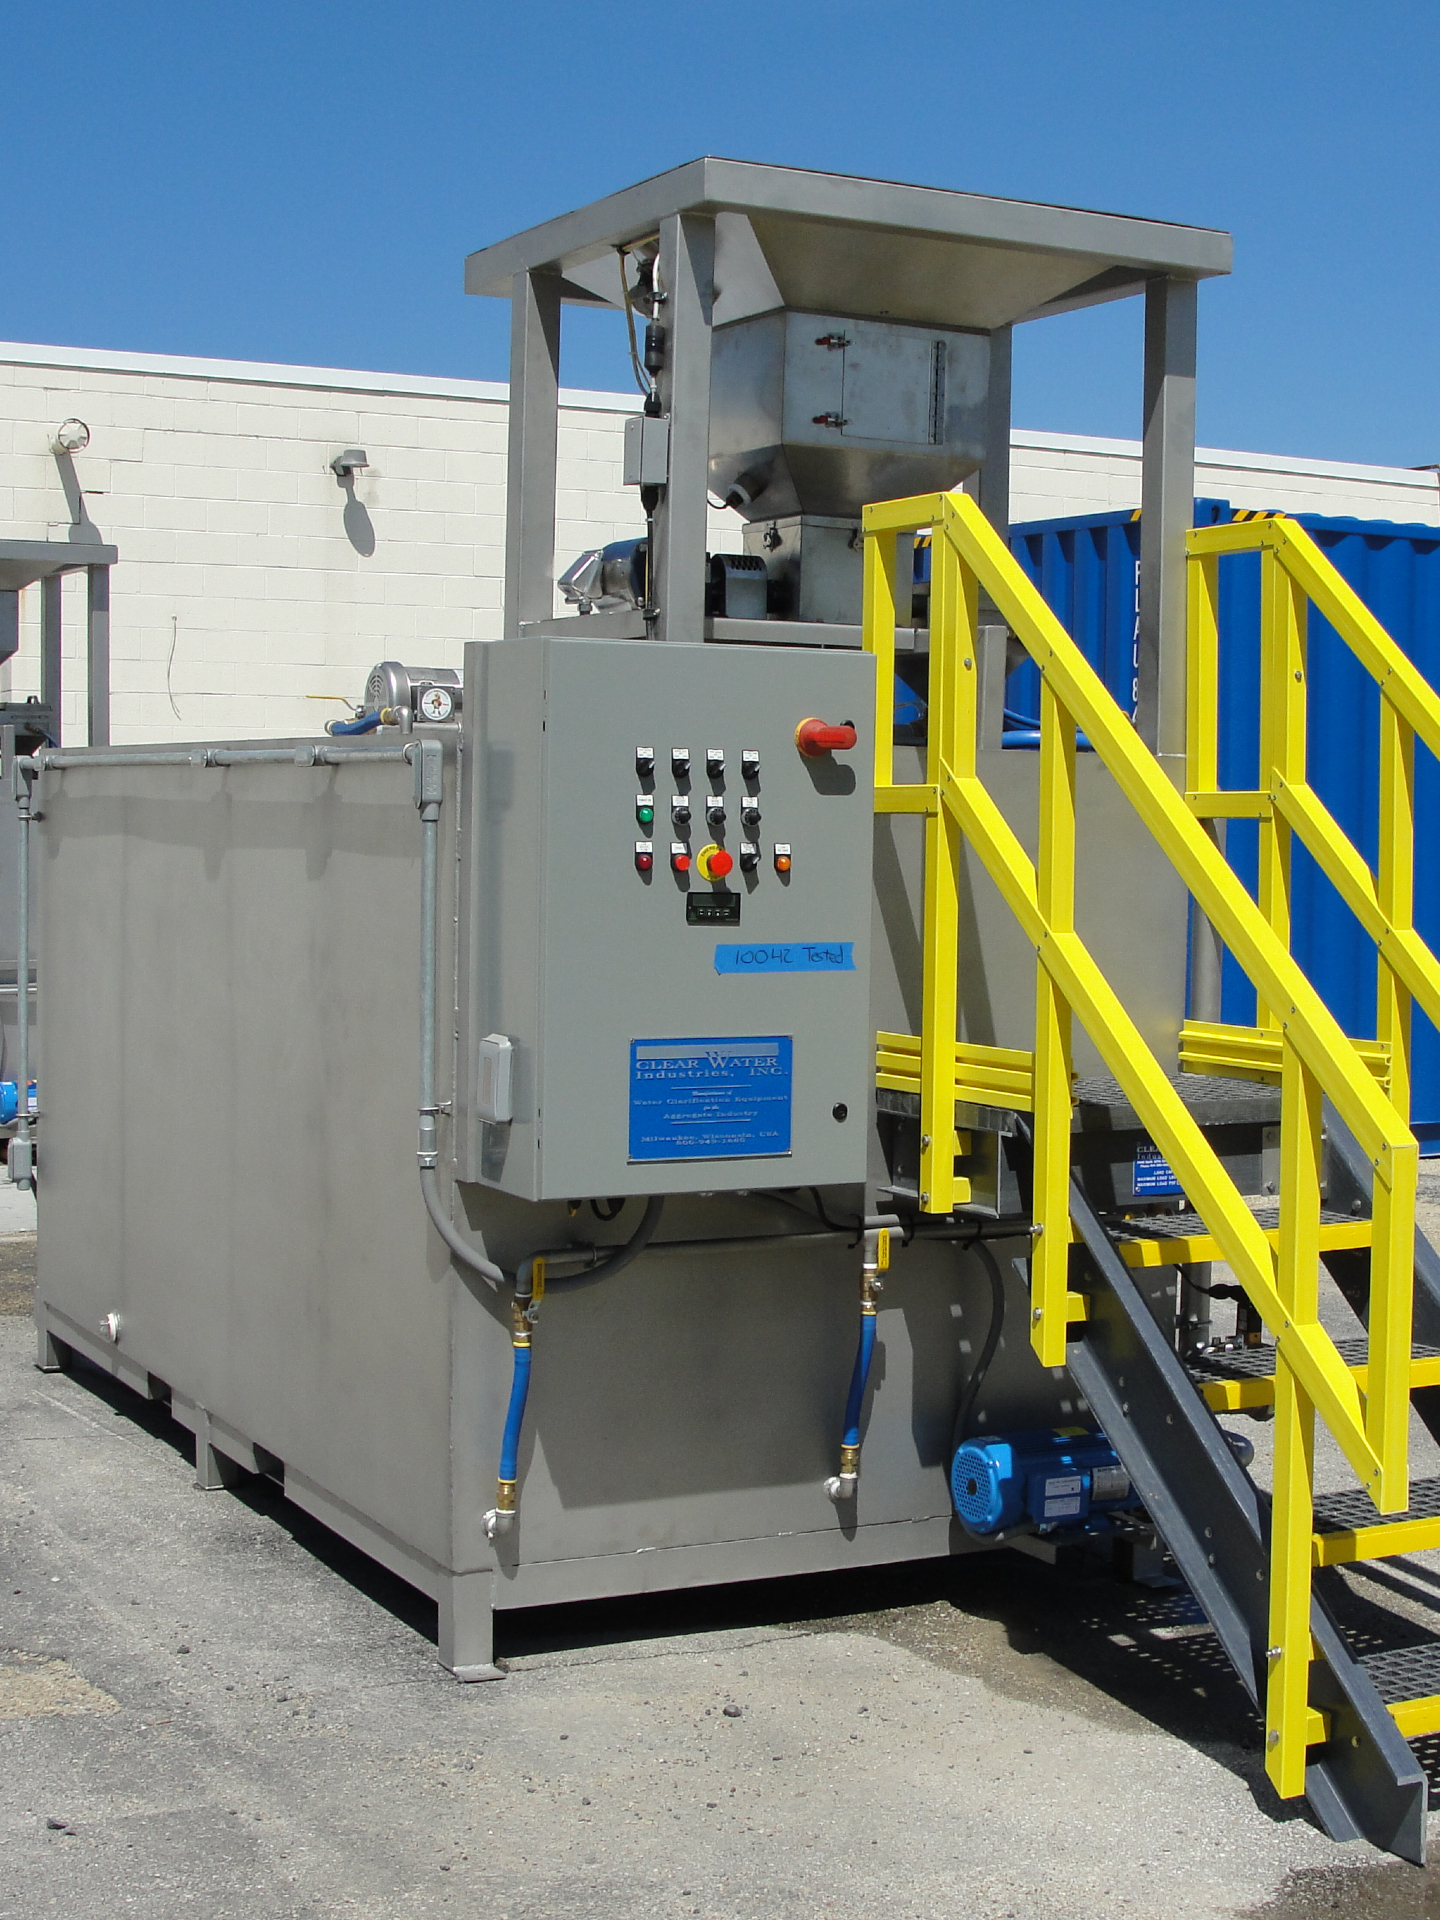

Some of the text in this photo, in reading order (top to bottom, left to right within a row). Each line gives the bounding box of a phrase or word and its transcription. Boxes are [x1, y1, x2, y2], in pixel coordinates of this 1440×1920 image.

[802, 945, 844, 964] Tested
[635, 1051, 778, 1071] CLEAR WATER
[749, 1067, 789, 1077] INC.
[666, 1097, 731, 1105] Clarification
[734, 1095, 789, 1103] Equipment
[663, 1110, 758, 1120] Aggregate Industry
